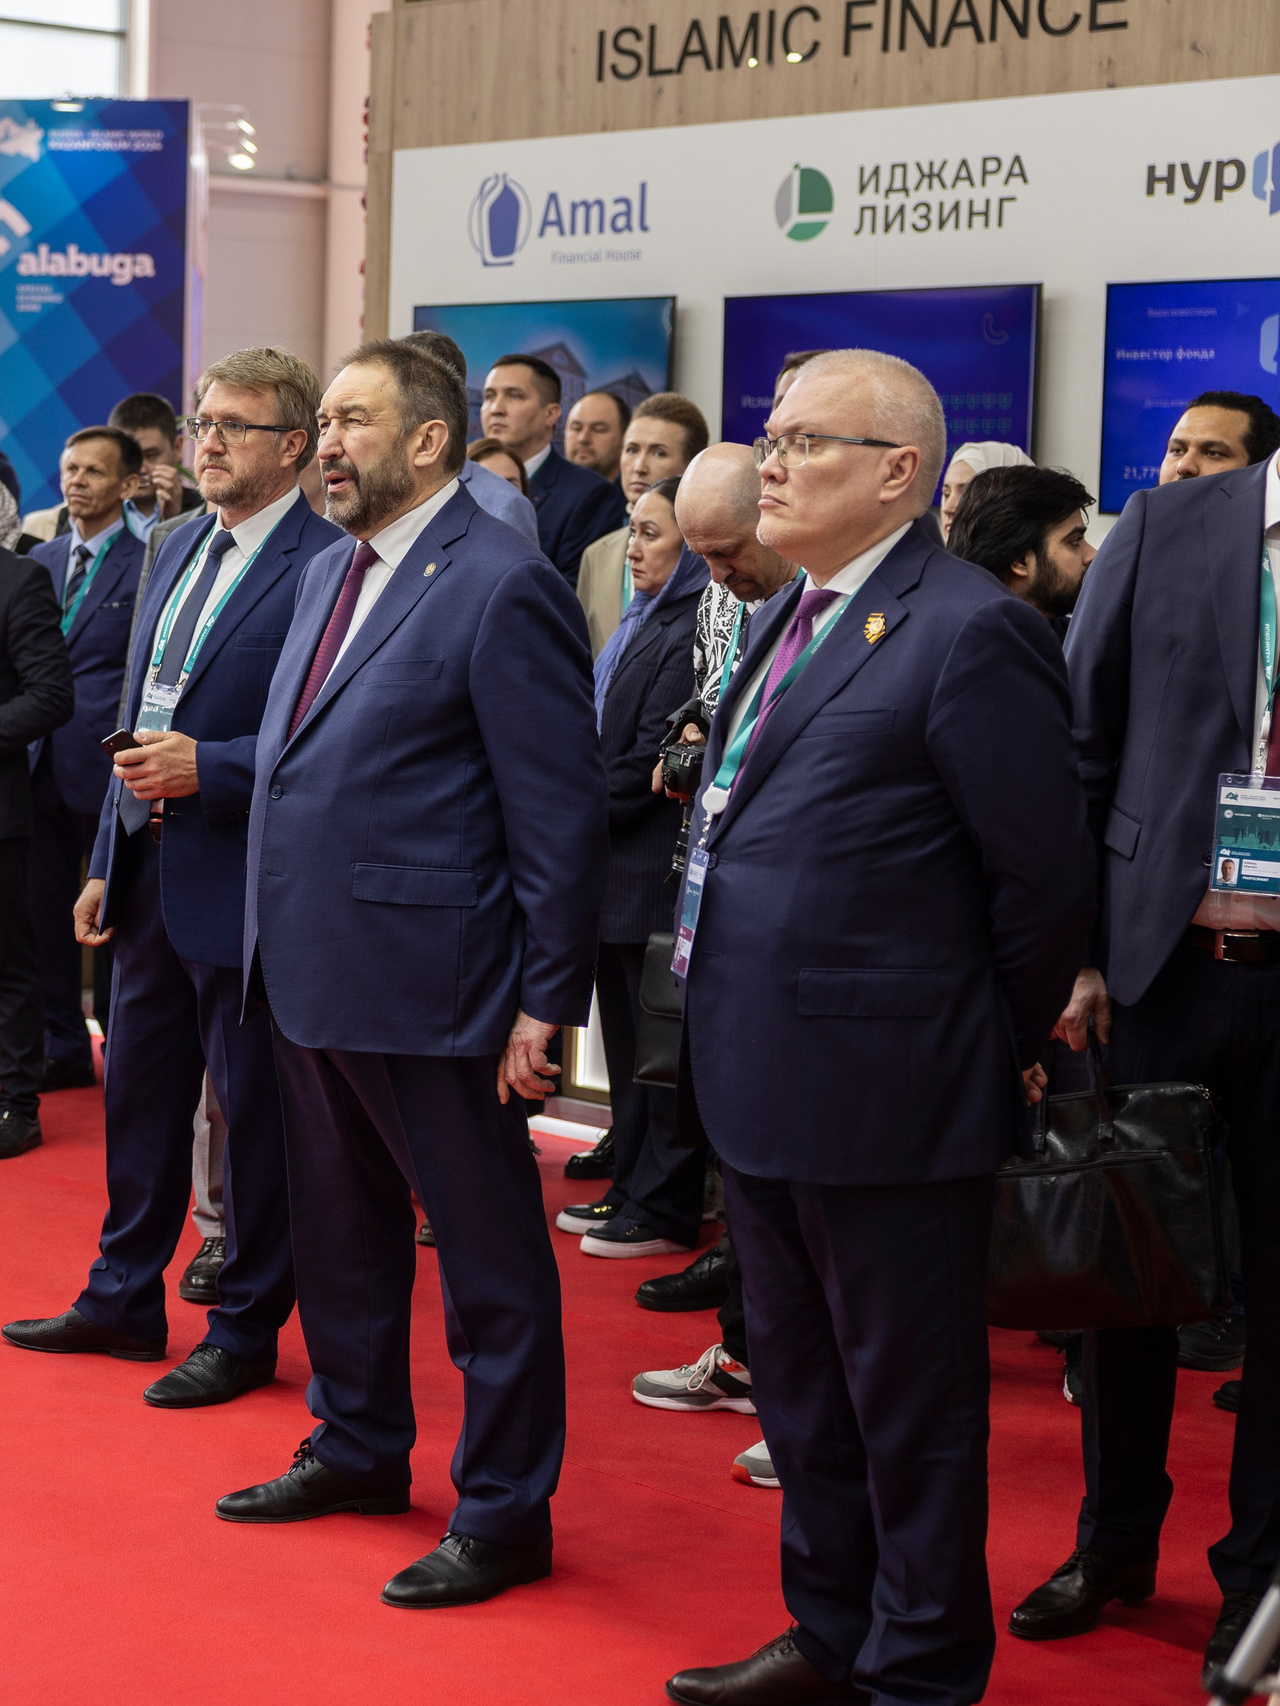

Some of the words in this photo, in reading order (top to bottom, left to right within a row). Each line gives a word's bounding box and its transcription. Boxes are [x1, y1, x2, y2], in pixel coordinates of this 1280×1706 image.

[596, 5, 821, 82] ISLAMIC
[843, 0, 1129, 57] FINANCE
[858, 155, 1029, 199] ИДЖАРА
[1146, 157, 1247, 205] нур
[538, 181, 650, 239] Amal
[853, 196, 1018, 236] ЛИЗИНГ
[17, 243, 156, 286] alabuga
[551, 249, 603, 264] Financial
[605, 247, 643, 262] House
[1115, 348, 1173, 363] Инвестор
[1176, 346, 1216, 363] фонда
